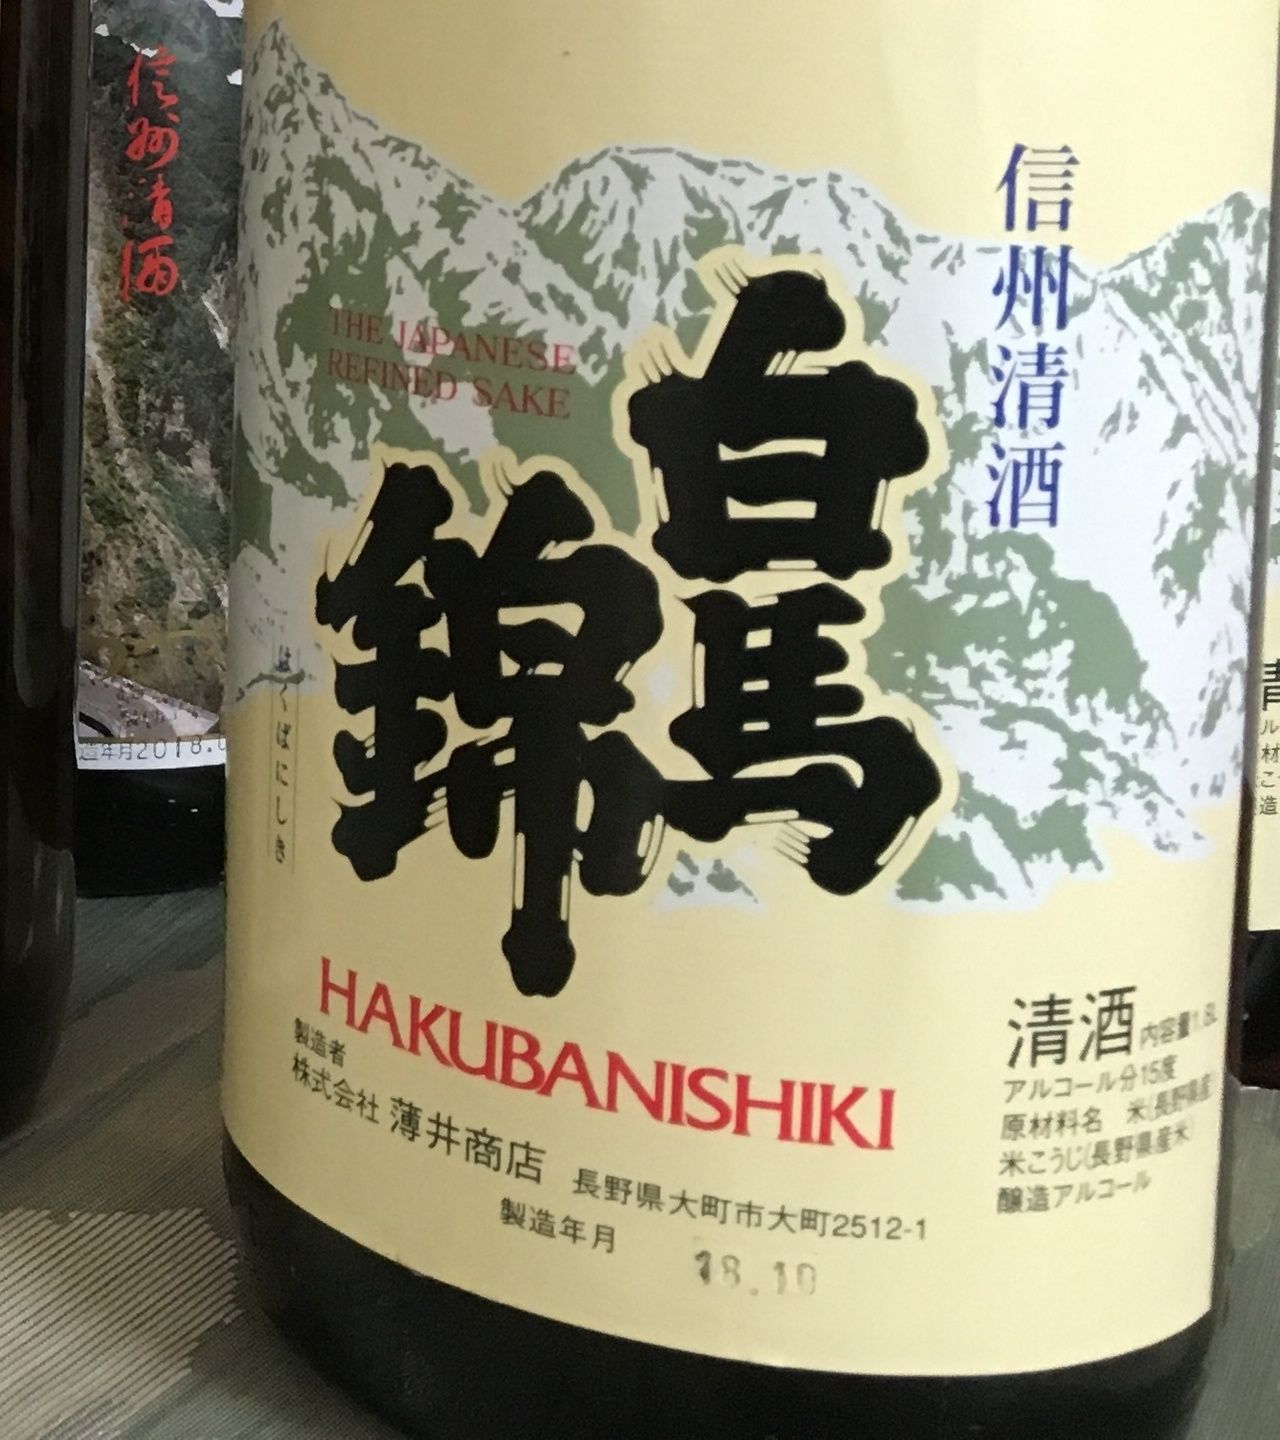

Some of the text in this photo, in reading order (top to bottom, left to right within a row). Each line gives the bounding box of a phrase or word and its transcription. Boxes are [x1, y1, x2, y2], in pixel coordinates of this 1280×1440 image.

[330, 308, 577, 376] THE JAPANESE
[984, 141, 1080, 529] 信州清酒
[327, 347, 572, 421] REFINED SAKE
[628, 267, 944, 897] 白馬
[315, 461, 665, 998] 錦
[293, 1017, 347, 1069] 製造者
[319, 955, 896, 1152] HAKUBANISHIKI
[1007, 985, 1138, 1069] 清酒
[291, 1052, 380, 1125] 株式会社
[499, 1196, 618, 1255] 製造年月
